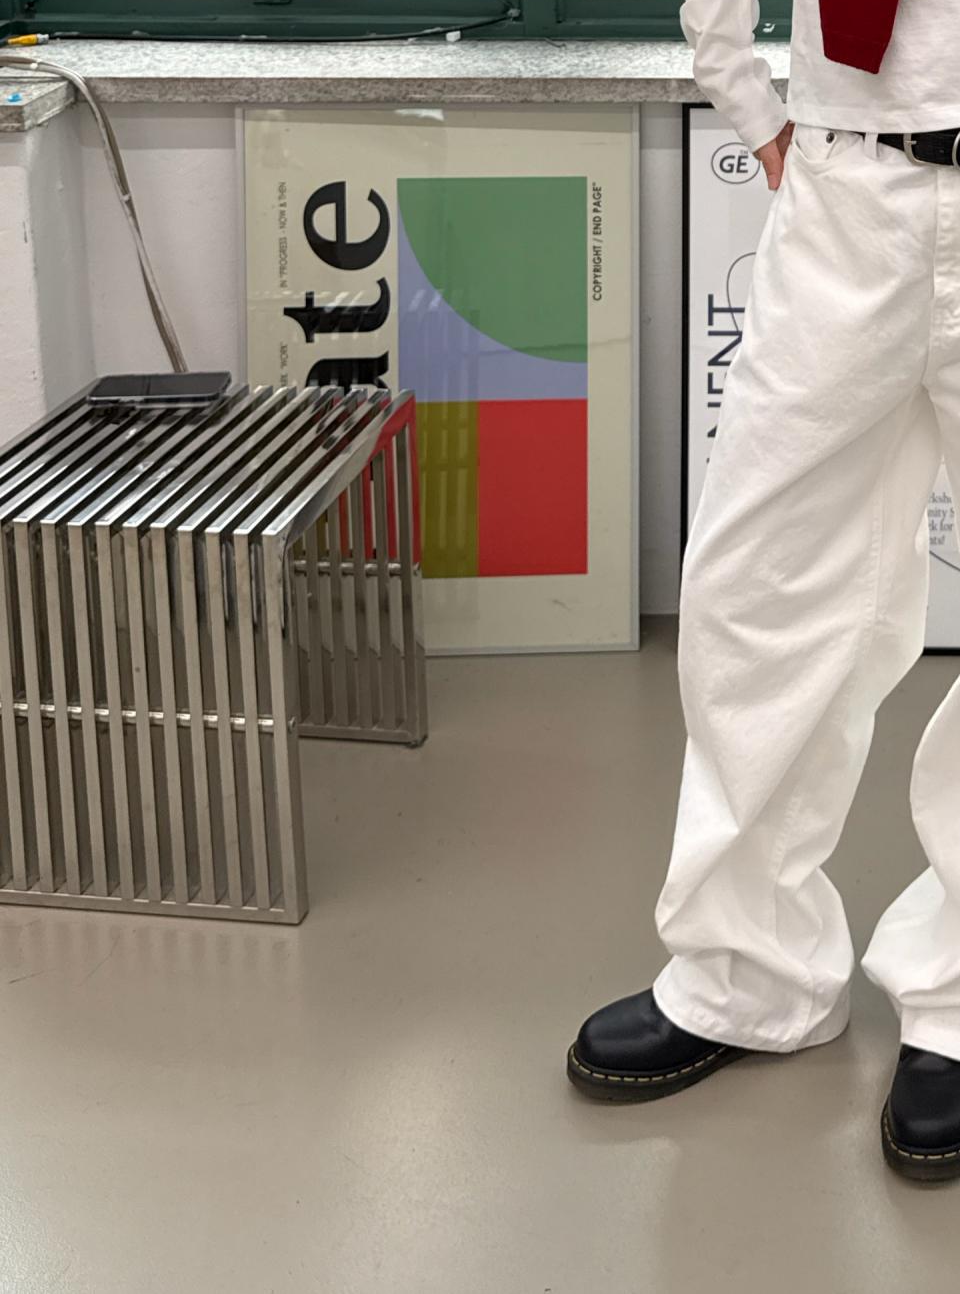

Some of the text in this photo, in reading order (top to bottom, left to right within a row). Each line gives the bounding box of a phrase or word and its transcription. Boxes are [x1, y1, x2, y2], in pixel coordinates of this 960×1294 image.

[719, 155, 748, 173] GE
[278, 181, 287, 201] THEN
[278, 209, 287, 229] NOW
[592, 216, 602, 236] END
[592, 245, 602, 301] COPYRIGHT
